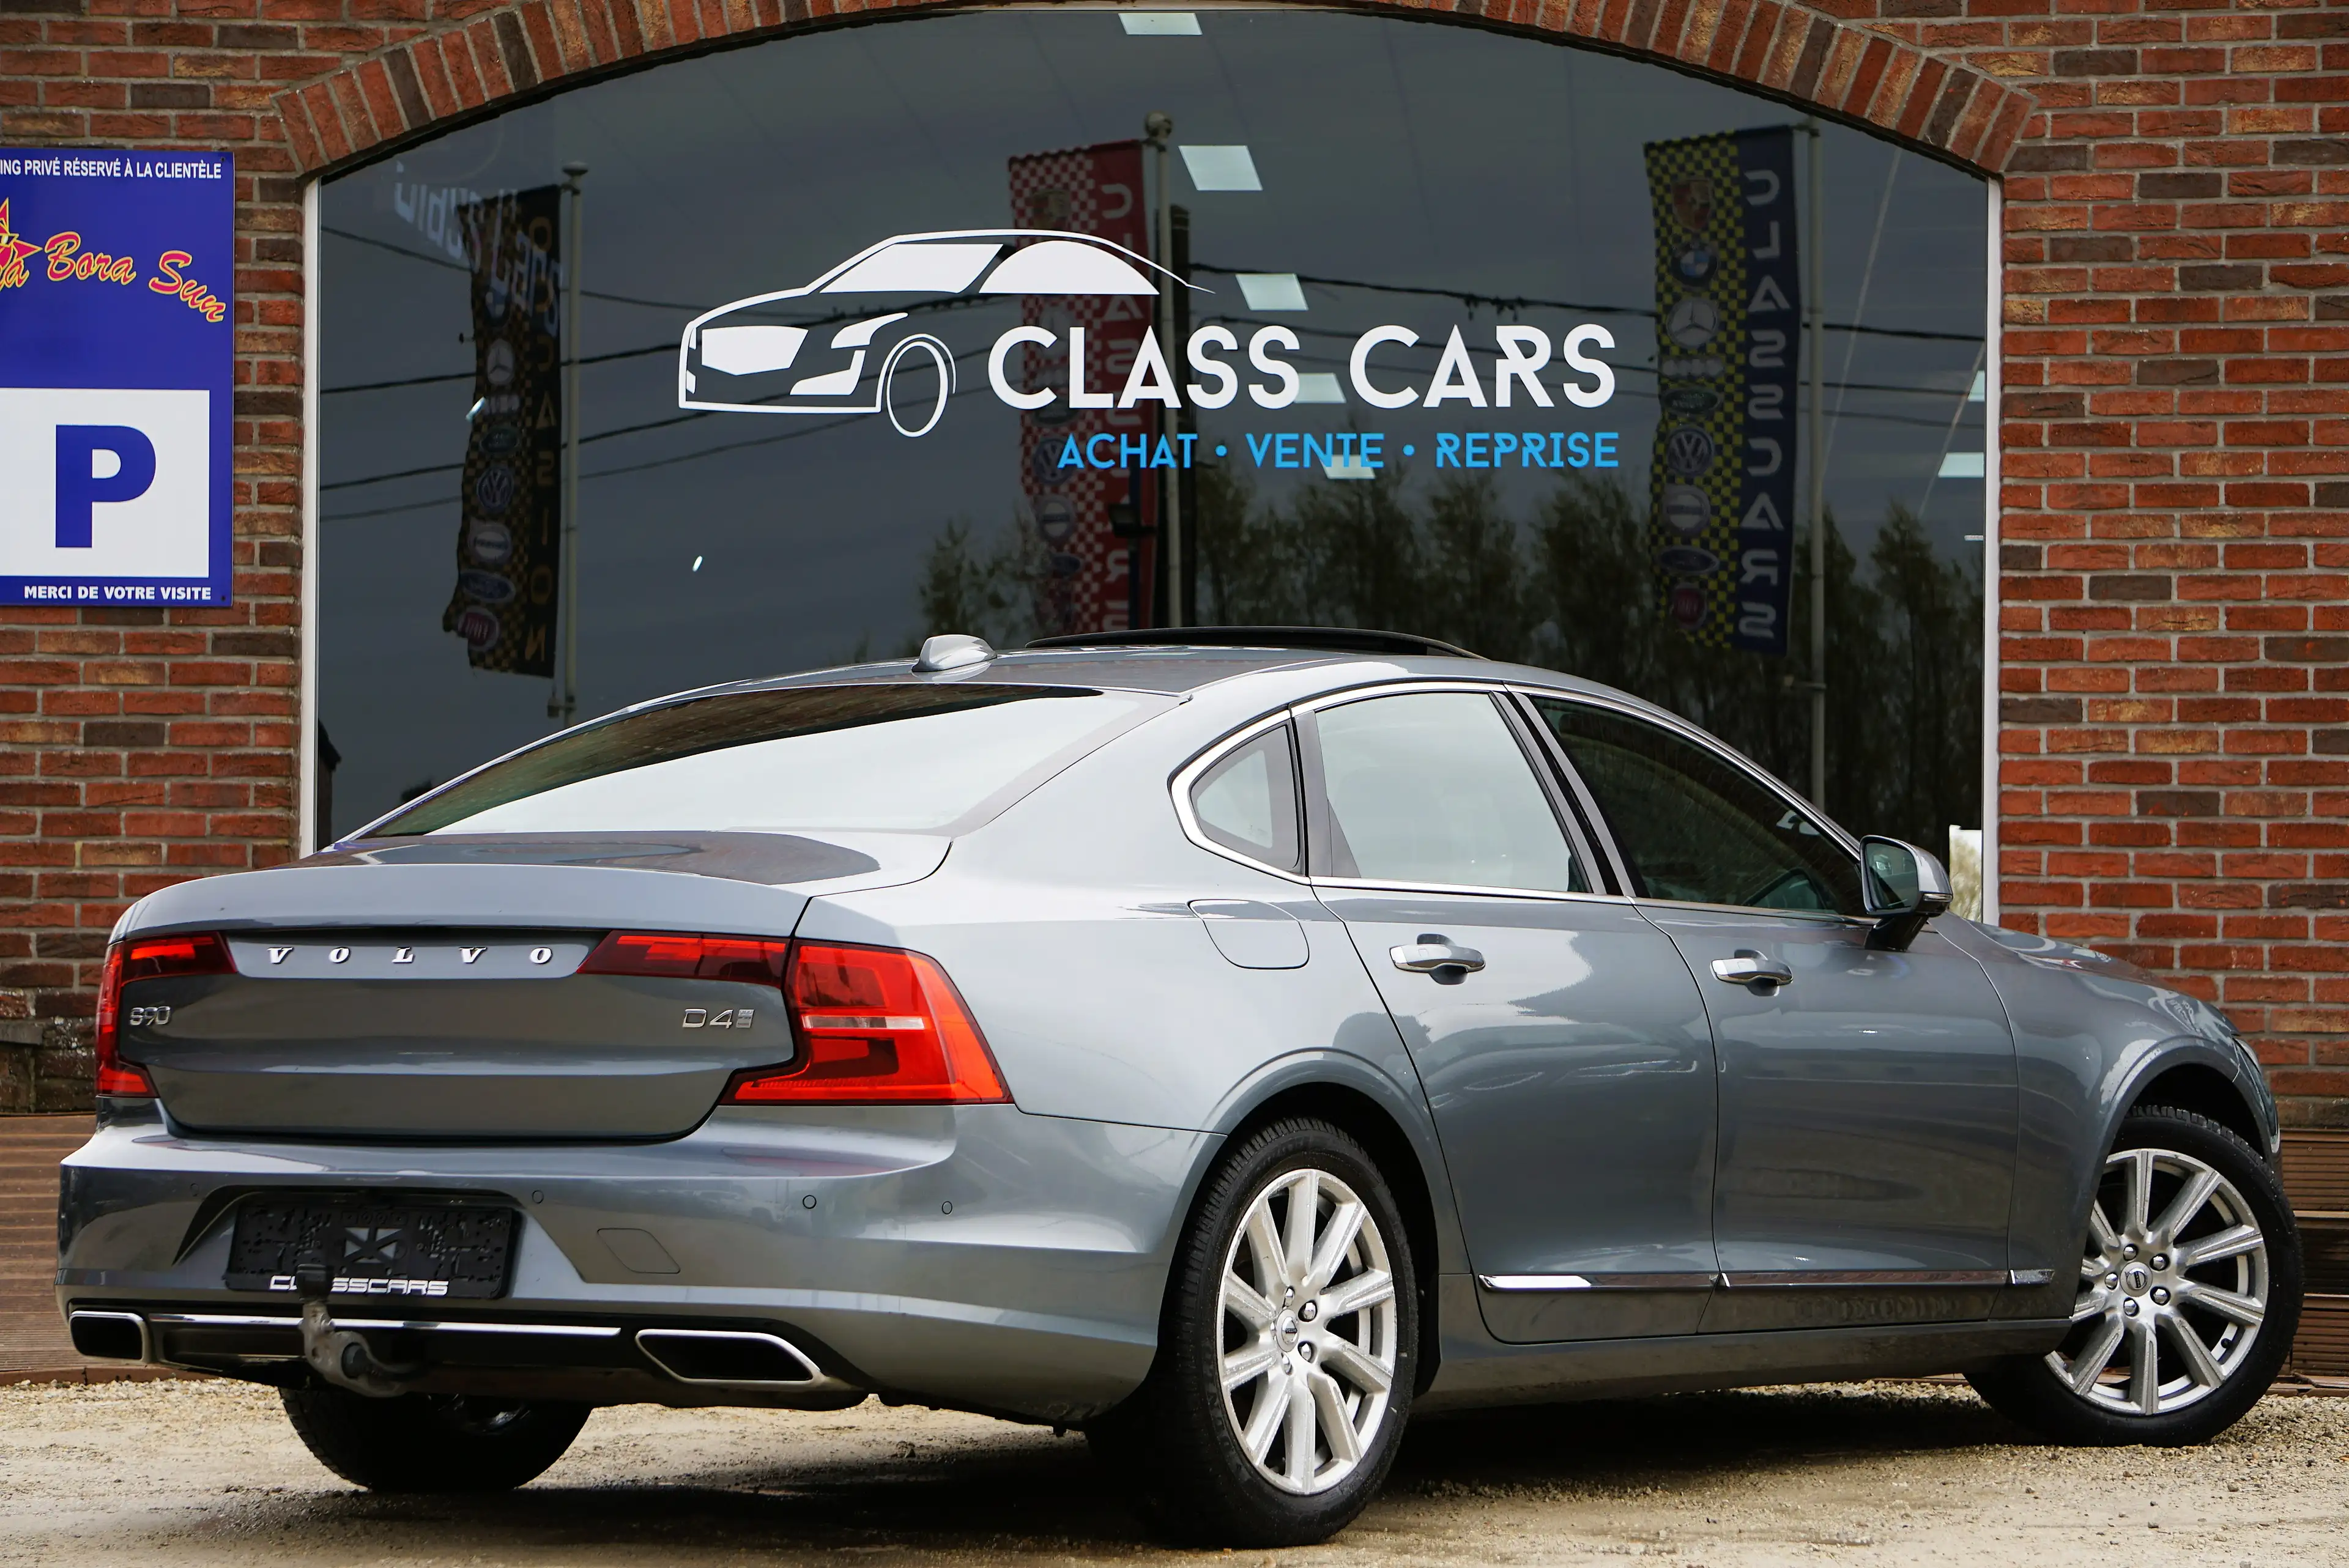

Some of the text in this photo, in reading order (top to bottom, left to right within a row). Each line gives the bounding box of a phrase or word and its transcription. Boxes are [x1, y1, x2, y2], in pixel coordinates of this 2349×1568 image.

[24, 157, 61, 176] PRIVÉ
[63, 157, 121, 177] RÉSERVÉ
[124, 158, 134, 178] À
[136, 161, 153, 178] LA
[154, 160, 222, 179] CLIENTÈLE
[44, 231, 137, 286] Bora
[149, 250, 226, 323] Sun
[988, 324, 1616, 409] CLASS CARS
[1058, 432, 1619, 468] ACHAT VENTE REPRISE
[55, 424, 156, 549] P
[24, 586, 212, 600] MERCI DE VOTRE VISITE
[266, 945, 554, 965] VOLVO
[130, 1005, 172, 1026] S90
[681, 1008, 734, 1030] D4
